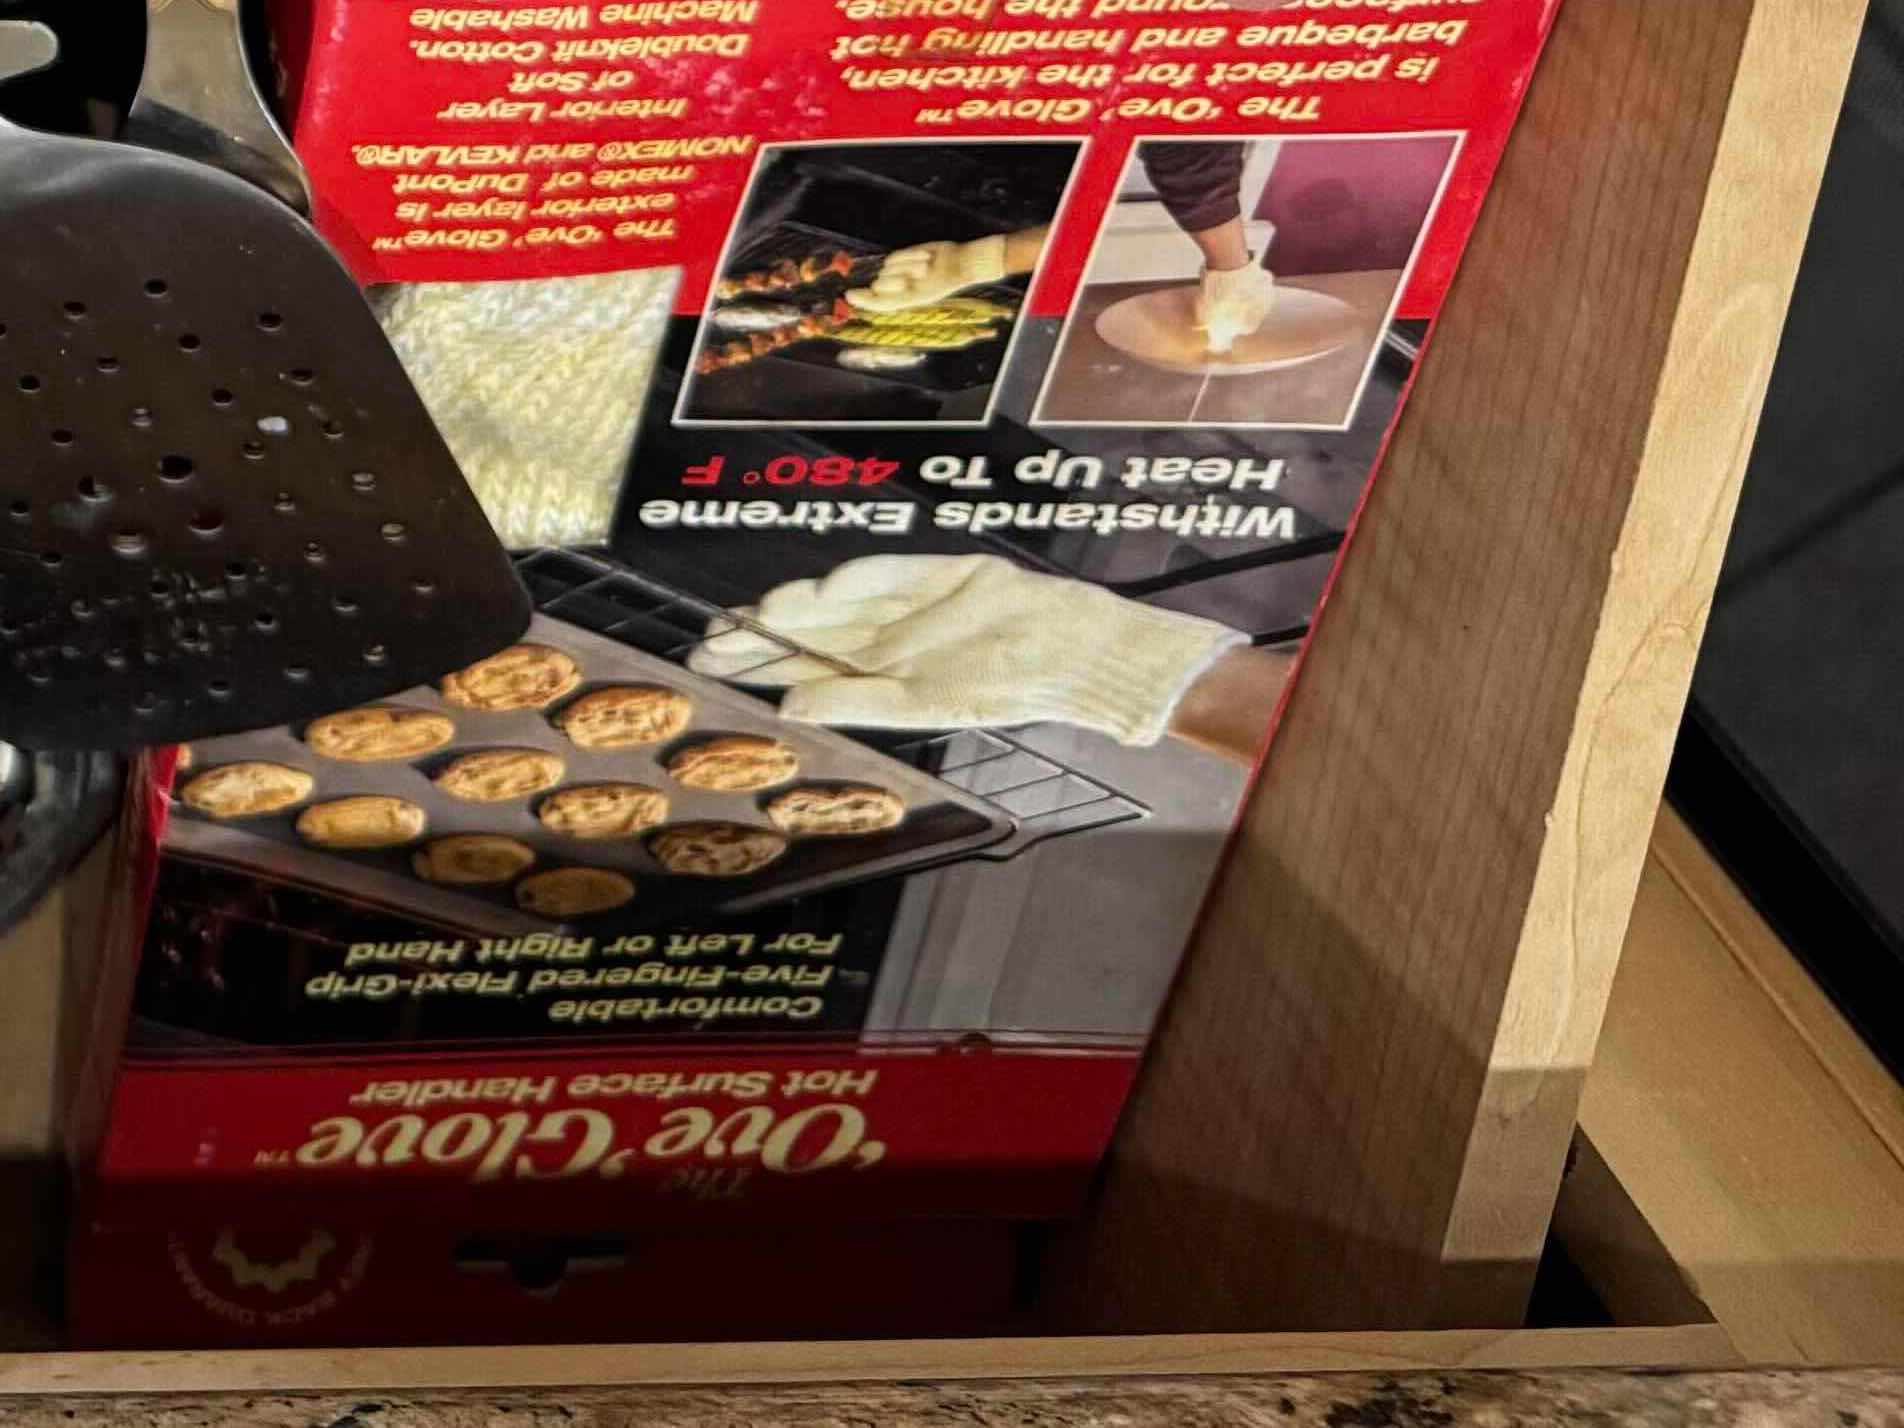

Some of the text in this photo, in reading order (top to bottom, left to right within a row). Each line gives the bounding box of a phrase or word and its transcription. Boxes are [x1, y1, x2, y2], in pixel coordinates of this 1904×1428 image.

[409, 0, 757, 31] Machine Washable
[409, 33, 750, 63] Doubleknit Cotton.
[830, 19, 1468, 60] barbeque and handling hot
[508, 69, 633, 93] of Soft
[841, 53, 1438, 92] is perfect for the kitchen,
[437, 98, 688, 122] Interior Layer
[1237, 94, 1321, 122] The
[524, 143, 594, 164] and
[392, 165, 694, 193] made of DuPont
[396, 193, 676, 222] exterior layer is
[613, 218, 675, 241] The
[681, 449, 1283, 490] Heat Up To 480° F
[639, 499, 1294, 540] Withstands Extreme
[345, 931, 842, 966] For Left or Right Hand
[304, 961, 834, 997] Five-Fingered Flexi-Grip
[547, 995, 823, 1023] Comfortable
[349, 1067, 877, 1107] Hot Surface Handler
